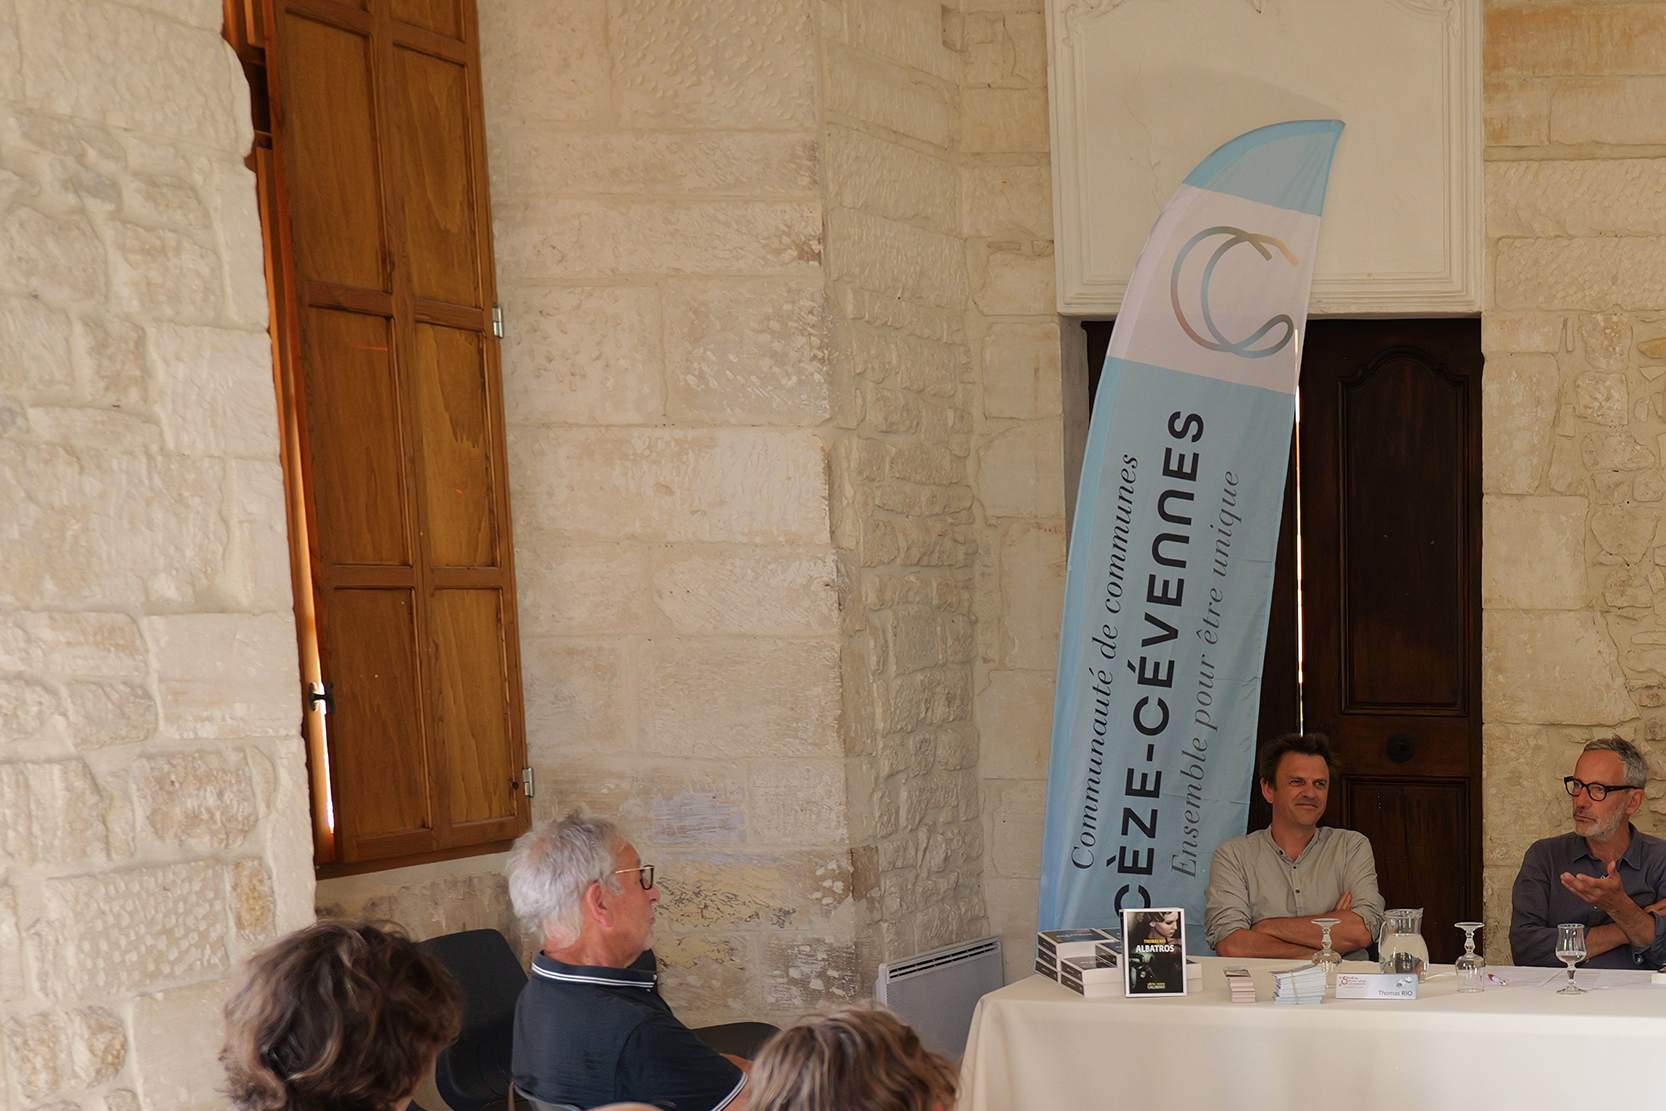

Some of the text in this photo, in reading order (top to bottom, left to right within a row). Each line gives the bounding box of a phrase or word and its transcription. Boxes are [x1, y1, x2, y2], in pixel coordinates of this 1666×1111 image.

[1071, 453, 1138, 869] Communauté de communes
[1171, 471, 1243, 878] Ensemble pour être unique
[1135, 944, 1175, 953] ALBATROS
